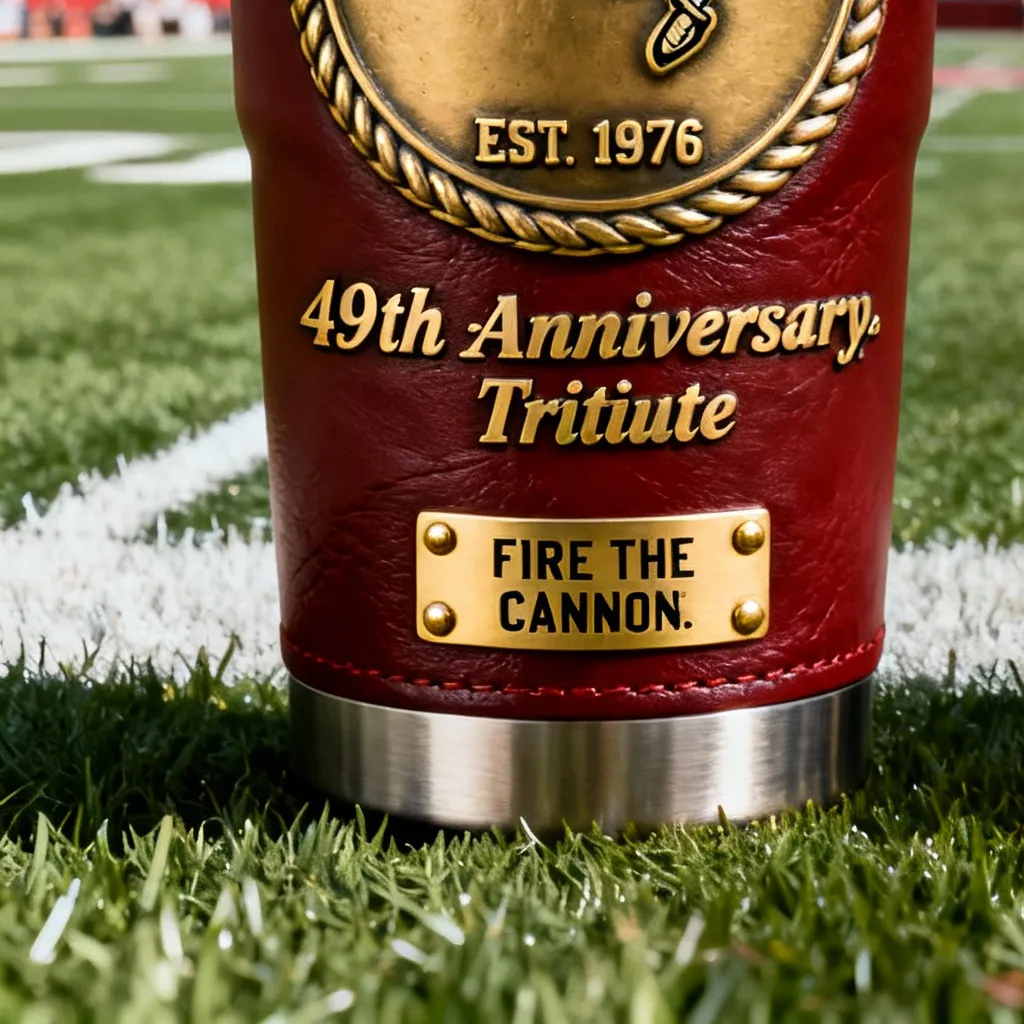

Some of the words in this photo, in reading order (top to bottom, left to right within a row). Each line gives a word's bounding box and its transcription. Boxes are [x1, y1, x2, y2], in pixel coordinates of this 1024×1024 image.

[474, 117, 576, 166] EST.
[593, 117, 705, 167] 1976
[299, 279, 446, 357] 49th
[492, 537, 594, 582] FIRE
[610, 536, 695, 580] THE
[499, 590, 694, 635] CANNON.
